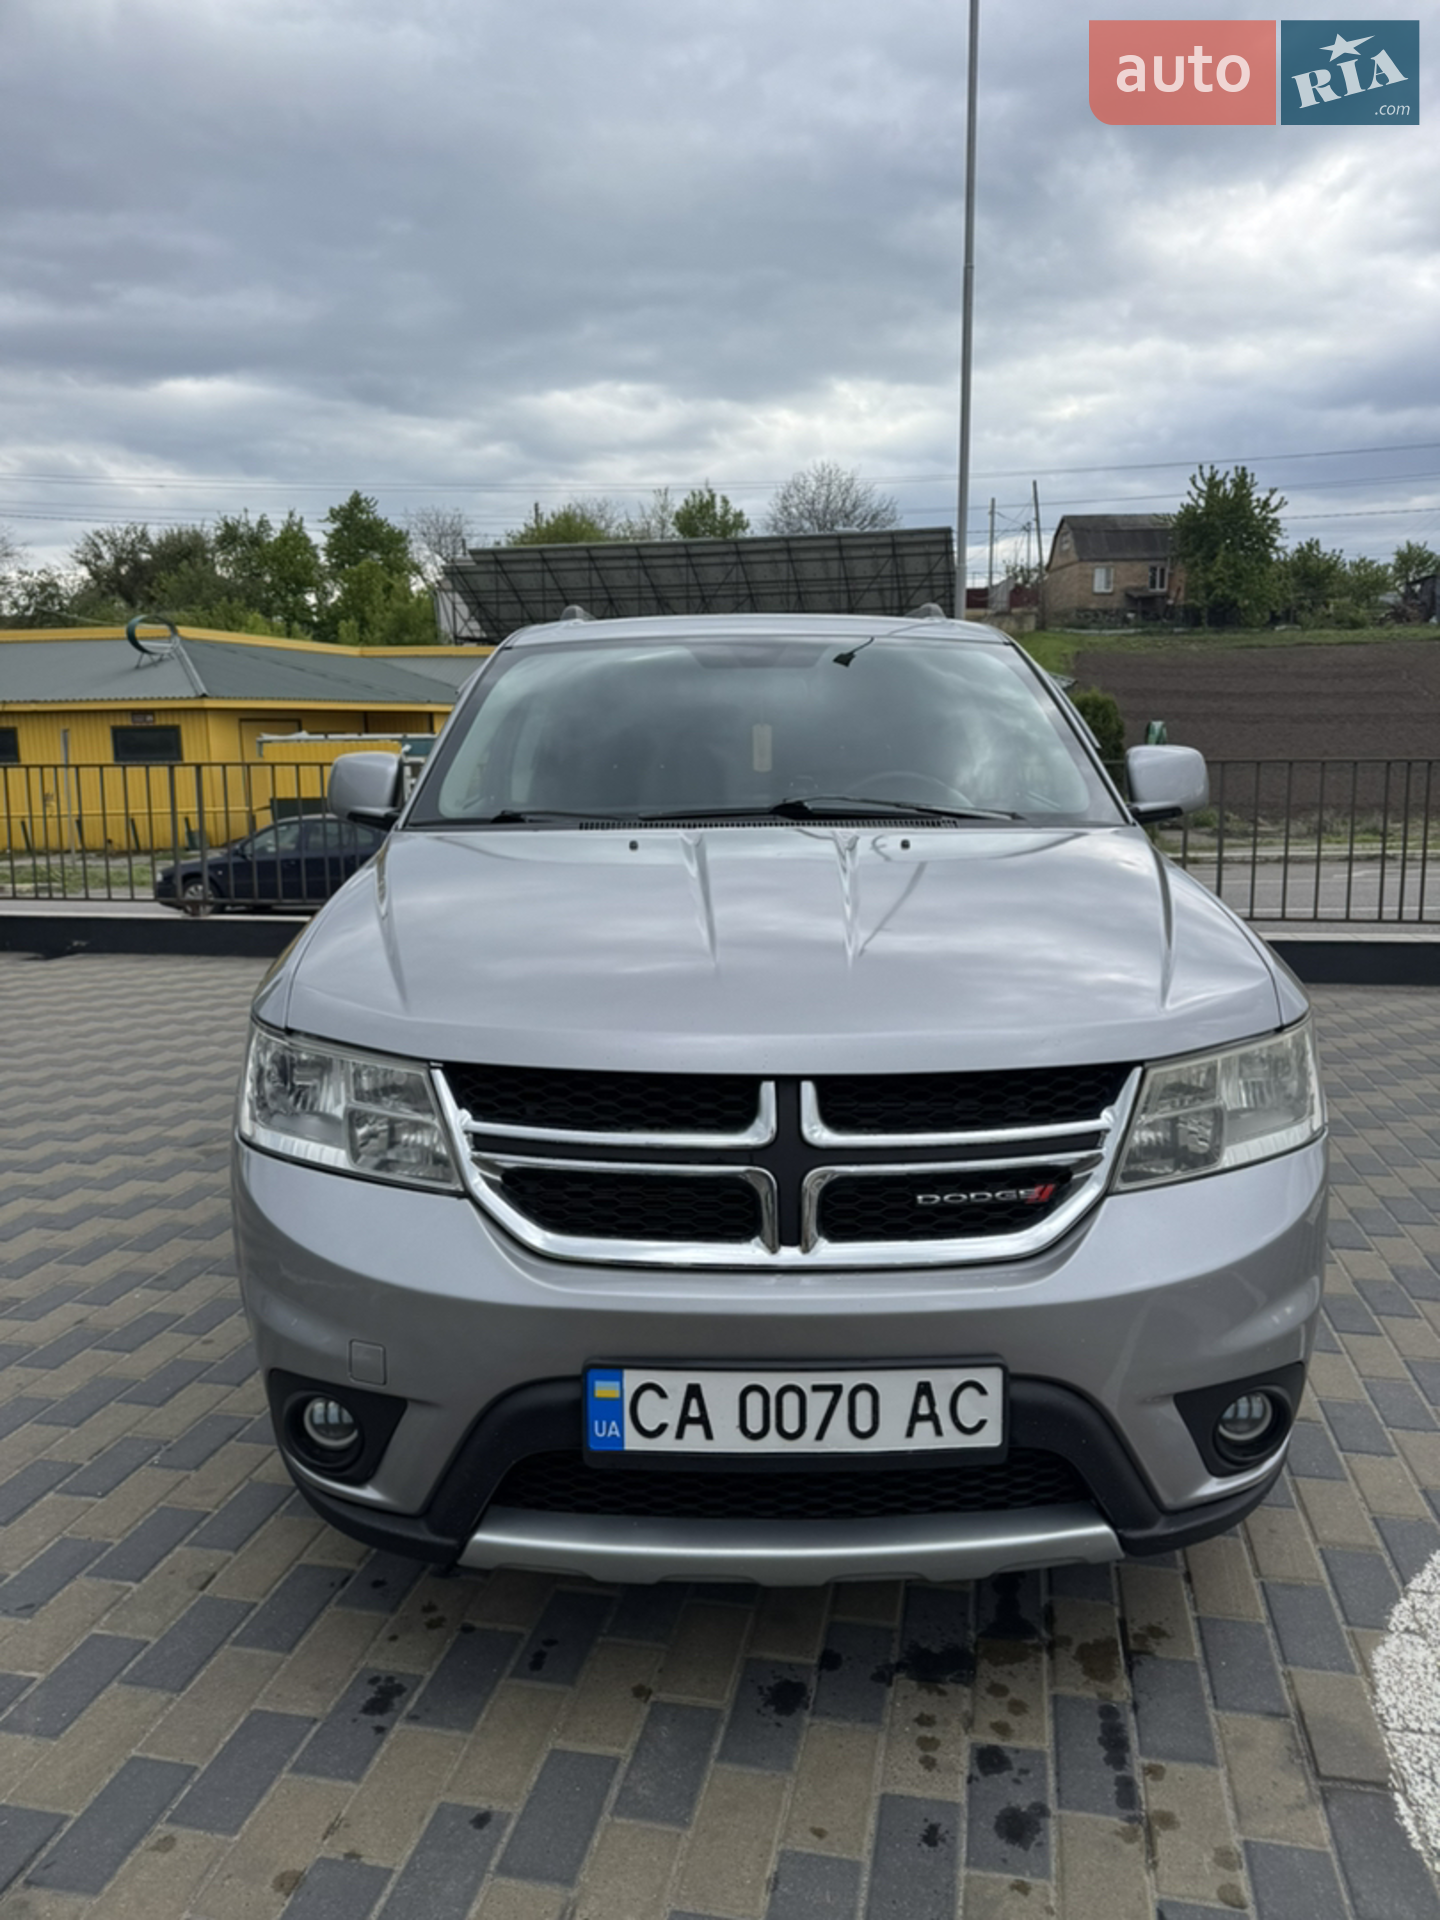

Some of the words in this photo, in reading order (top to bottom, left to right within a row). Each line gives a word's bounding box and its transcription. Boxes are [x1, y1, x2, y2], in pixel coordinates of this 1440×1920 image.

[916, 1188, 1040, 1205] DODGE
[629, 1382, 714, 1440] CA
[738, 1383, 880, 1441] 0070
[905, 1380, 989, 1437] AC
[594, 1420, 621, 1438] UA
